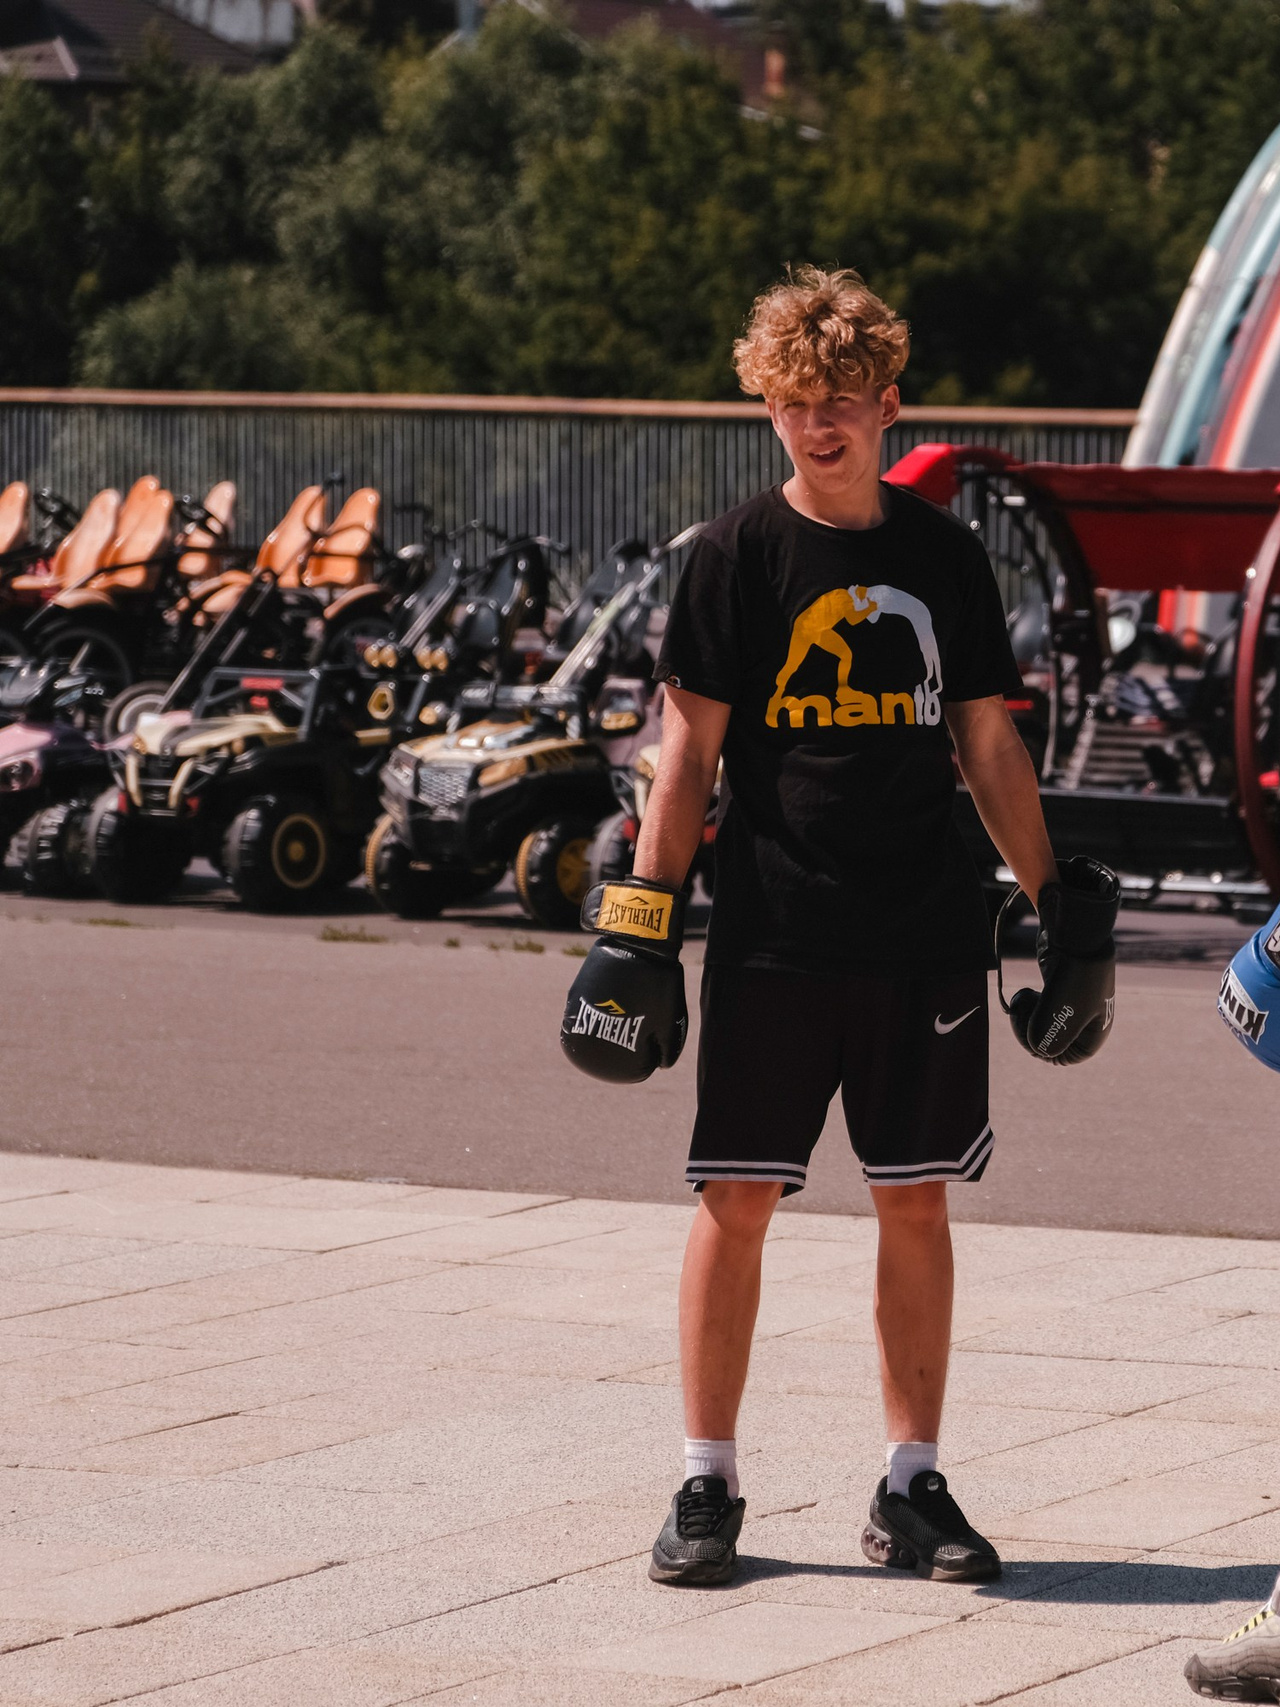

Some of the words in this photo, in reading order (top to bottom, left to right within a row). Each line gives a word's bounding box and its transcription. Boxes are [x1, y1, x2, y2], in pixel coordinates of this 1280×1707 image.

[605, 901, 665, 933] EVERLAST
[571, 997, 646, 1052] EVERLAST
[1037, 1005, 1075, 1058] Professional
[1218, 968, 1265, 1043] KIN
